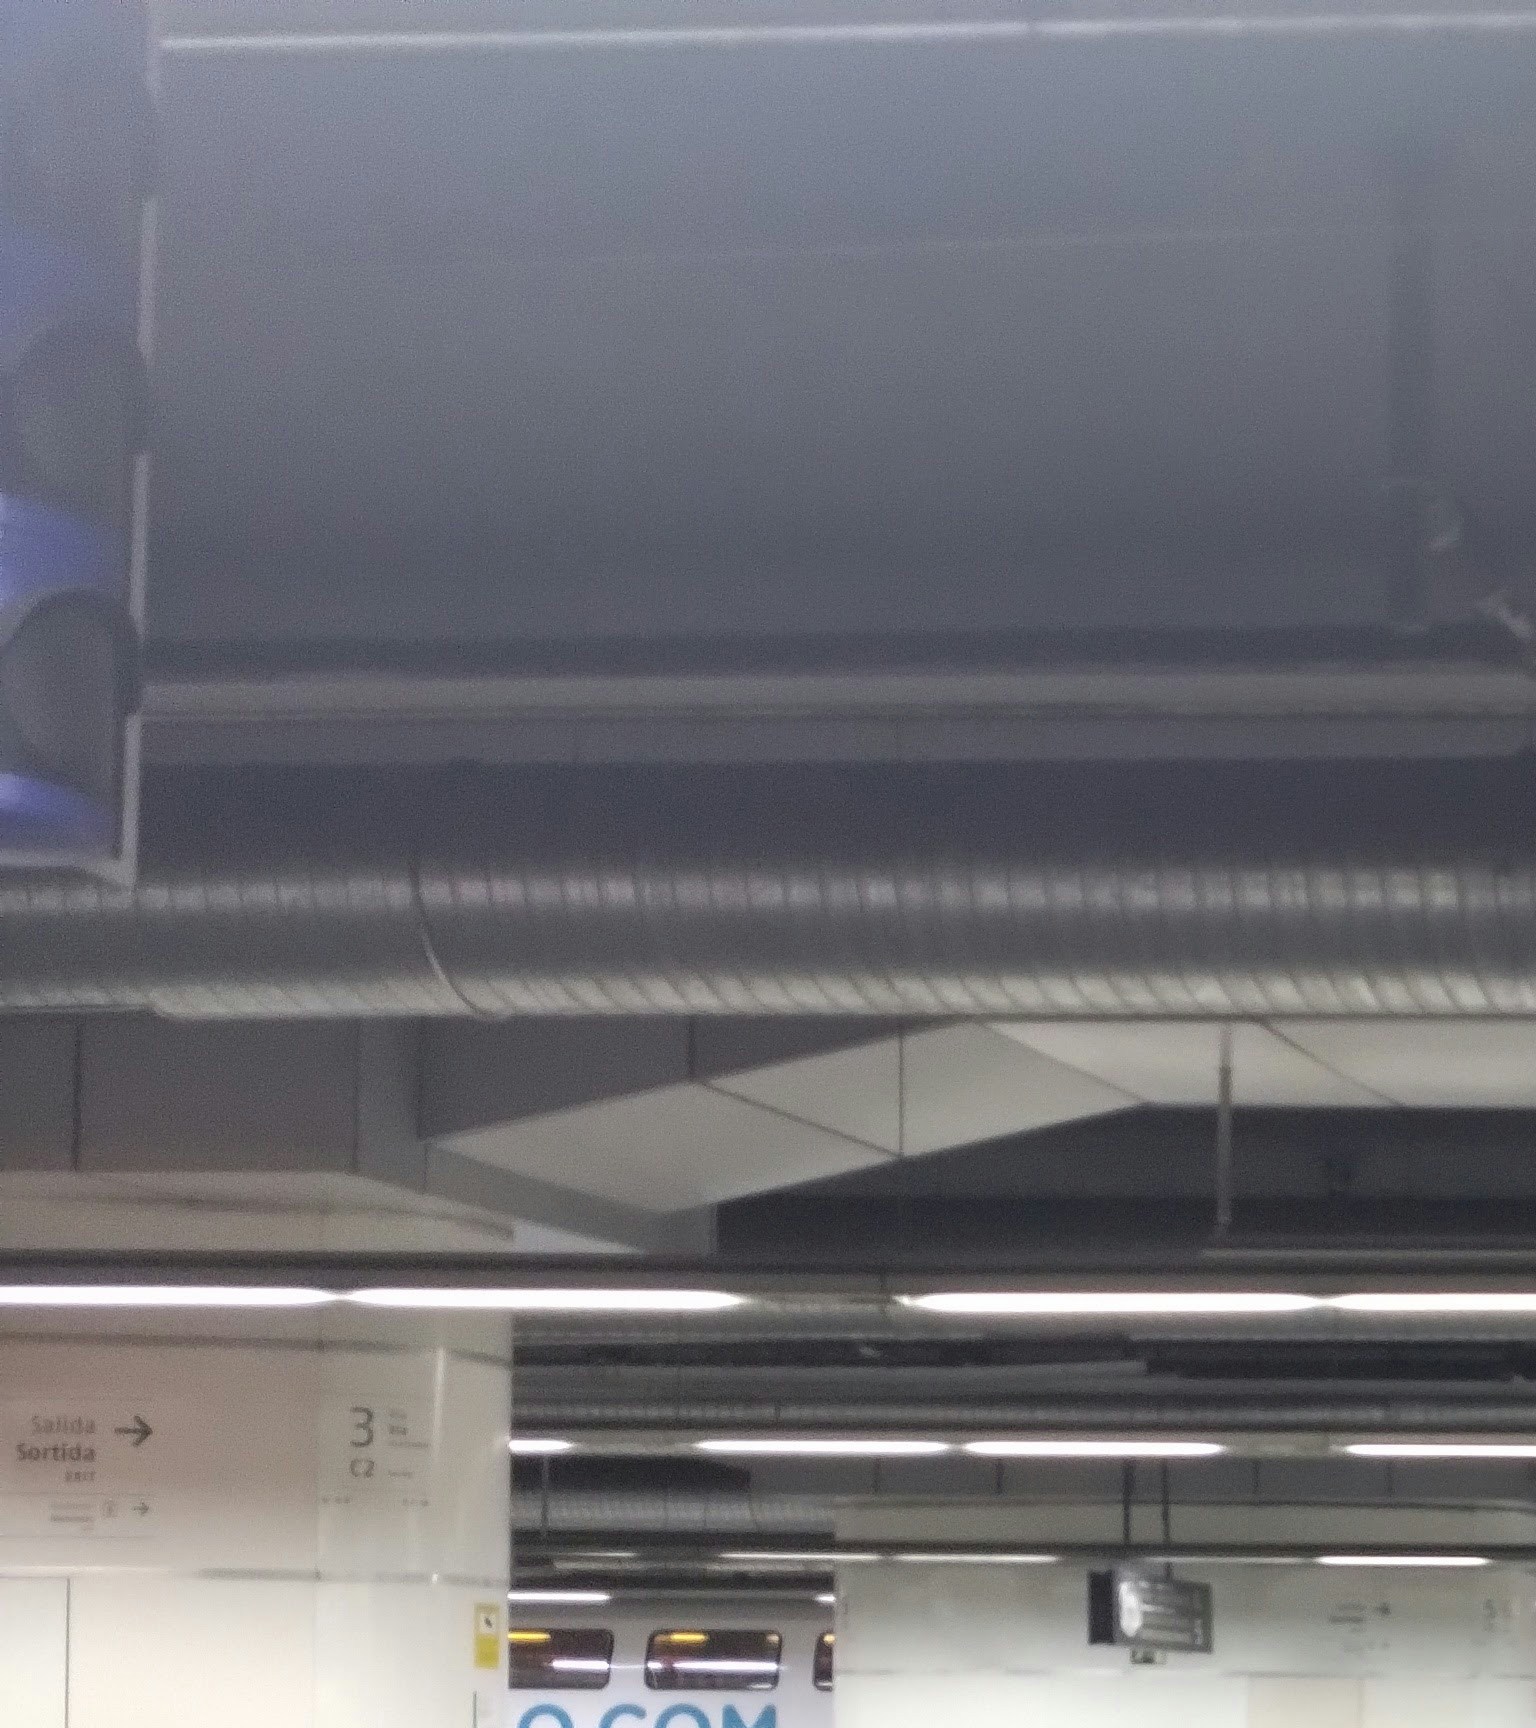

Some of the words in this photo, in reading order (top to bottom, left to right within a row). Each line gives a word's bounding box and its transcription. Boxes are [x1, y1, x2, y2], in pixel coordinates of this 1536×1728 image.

[31, 1415, 96, 1434] Salida
[349, 1406, 374, 1448] 3
[15, 1442, 97, 1463] Sortida
